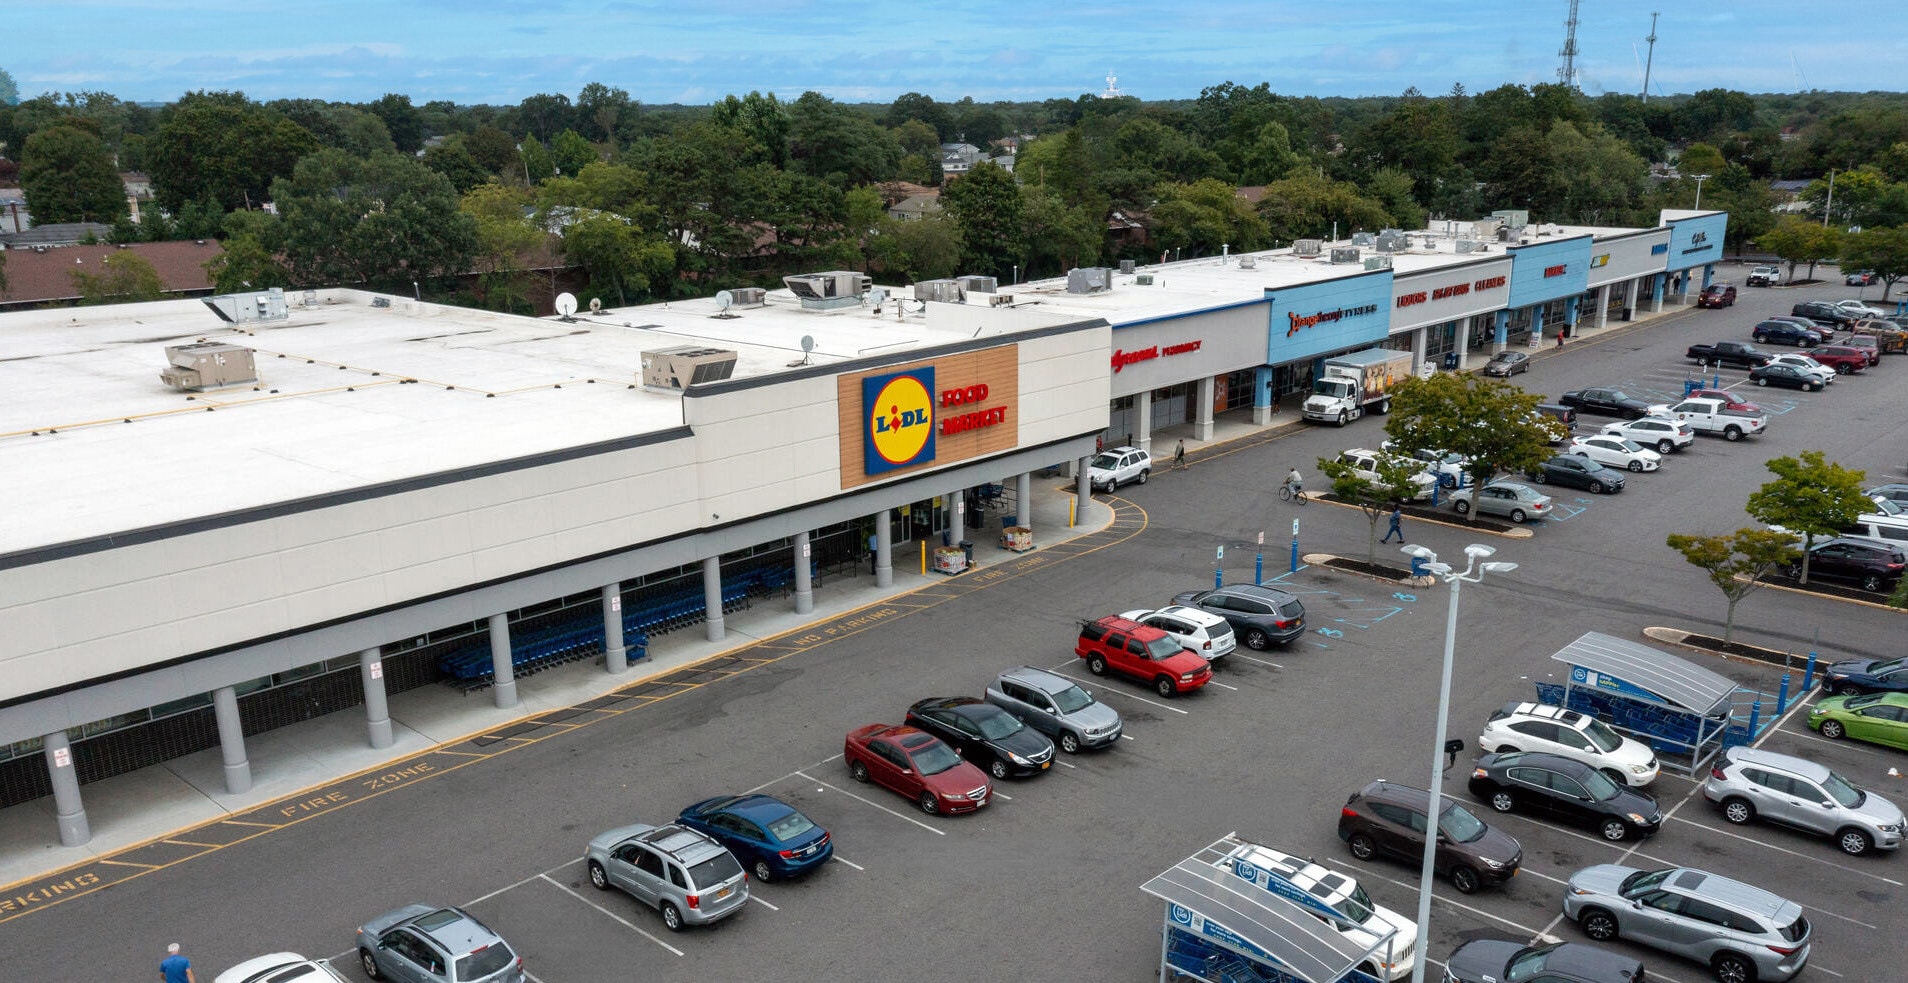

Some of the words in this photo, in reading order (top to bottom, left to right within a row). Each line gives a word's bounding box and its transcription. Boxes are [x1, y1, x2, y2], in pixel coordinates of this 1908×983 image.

[942, 383, 989, 409] FOOD
[942, 406, 1008, 436] MARKET
[793, 634, 822, 645] NO
[824, 608, 898, 635] PARKING
[280, 791, 349, 817] FIRE
[362, 762, 435, 790] ZONE
